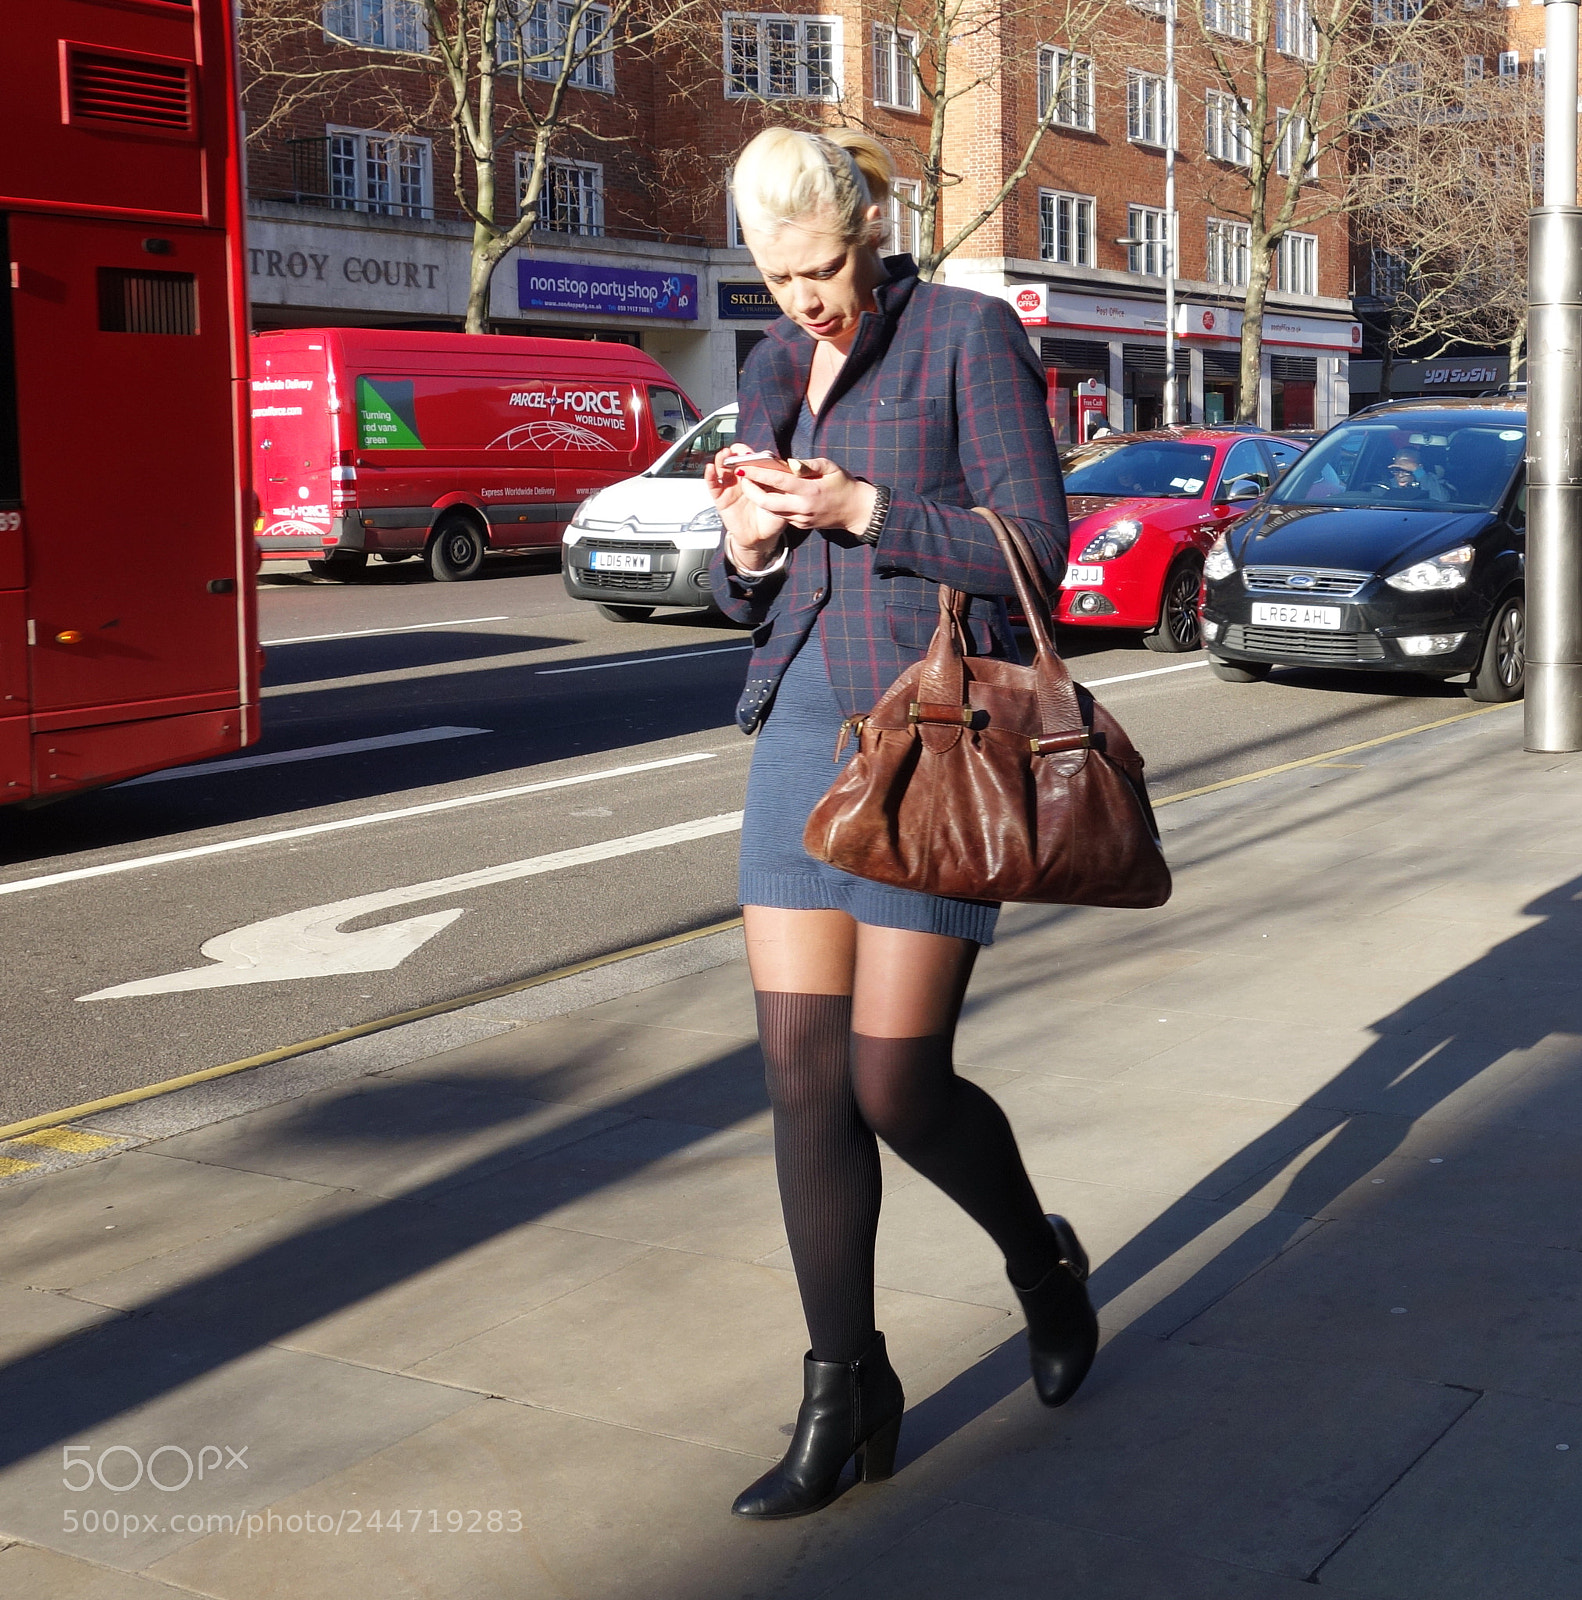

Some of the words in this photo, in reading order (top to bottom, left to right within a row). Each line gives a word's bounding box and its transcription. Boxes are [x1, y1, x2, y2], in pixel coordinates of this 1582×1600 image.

[249, 248, 329, 280] TROY
[343, 257, 439, 289] COURT
[530, 276, 556, 292] non
[557, 277, 588, 298] stop
[590, 281, 626, 302] party
[627, 281, 658, 303] shop
[1018, 300, 1039, 308] OFFICE
[1021, 293, 1036, 301] POST
[1095, 305, 1108, 316] Post
[1109, 307, 1125, 319] Office
[509, 392, 547, 408] PARCEL
[563, 391, 624, 415] FORCE
[360, 410, 392, 422] Turning
[574, 414, 626, 430] WORLDWIDE
[362, 423, 377, 432] red
[377, 424, 398, 432] vans
[364, 436, 388, 446] green
[481, 488, 503, 497] Express
[504, 488, 533, 496] Worldwide
[534, 487, 556, 496] Delivery
[599, 554, 622, 567] LD15
[624, 555, 646, 568] RWW
[1071, 568, 1099, 582] RJJ
[1260, 606, 1298, 623] LR62
[1303, 609, 1332, 625] AHL
